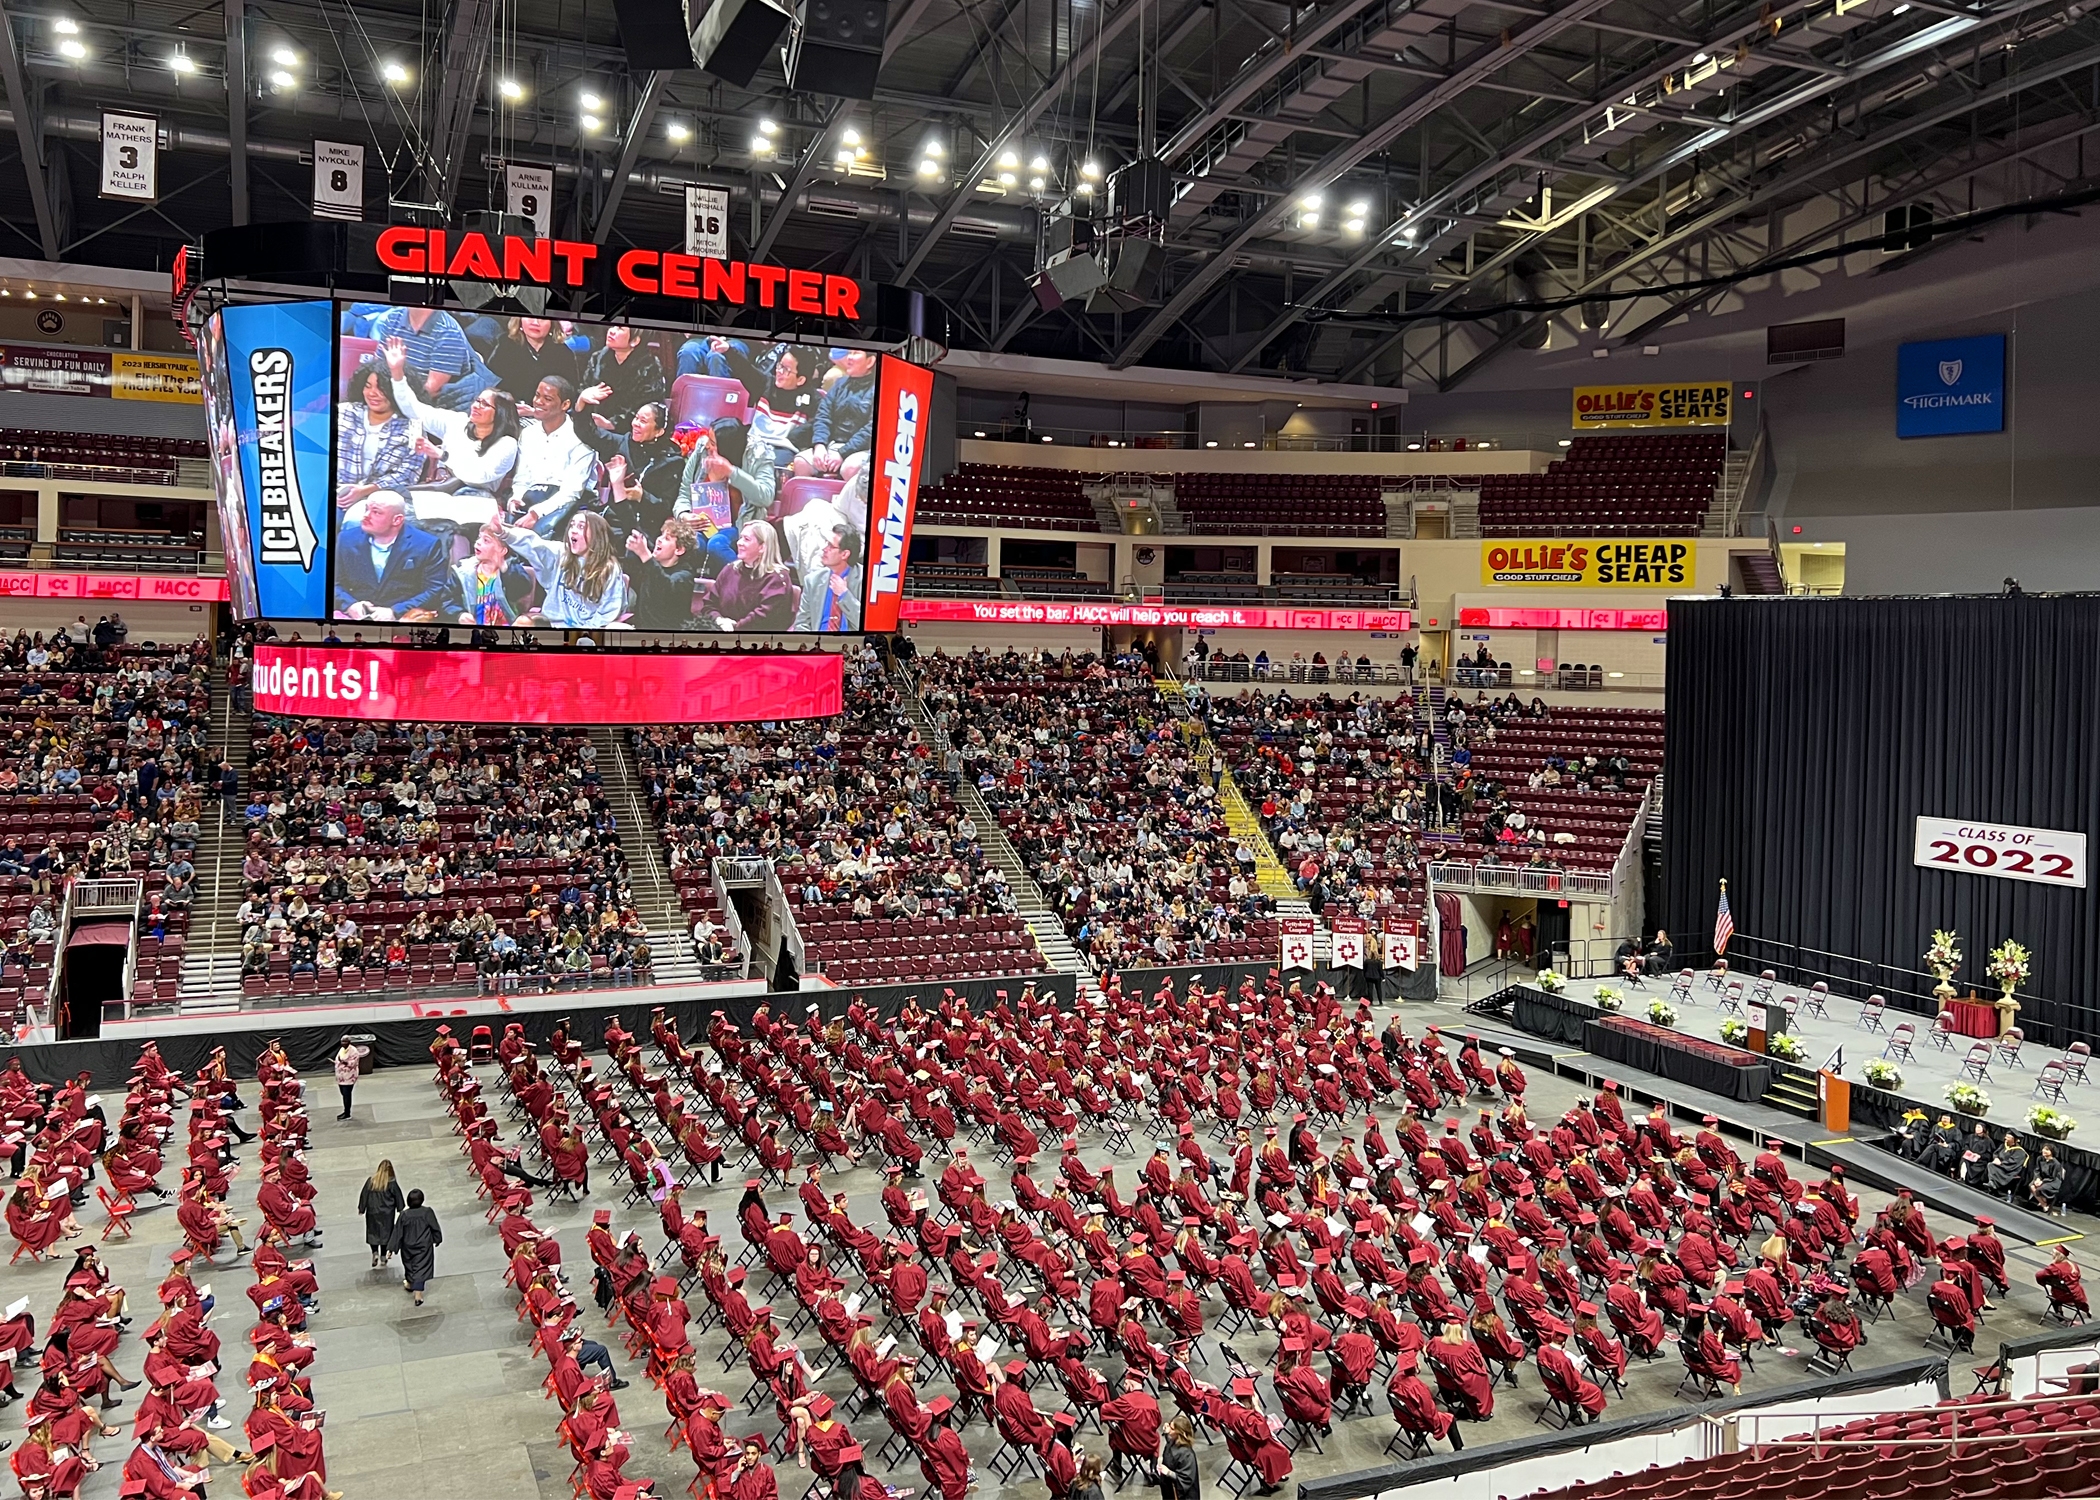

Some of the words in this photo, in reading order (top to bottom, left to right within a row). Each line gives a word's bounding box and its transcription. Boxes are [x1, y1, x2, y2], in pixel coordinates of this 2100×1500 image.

[112, 122, 146, 133] FRANK
[106, 131, 153, 143] MATHERS
[119, 145, 139, 169] 3
[328, 147, 350, 157] MIKE
[318, 155, 359, 167] NYKOLUK
[112, 170, 145, 181] RALPH
[330, 169, 348, 192] 8
[518, 173, 542, 183] ARNIE
[109, 179, 147, 190] KELLER
[511, 181, 549, 192] KULLMAN
[521, 194, 538, 217] 9
[689, 201, 725, 212] MARSHALL
[694, 214, 720, 235] 16
[696, 239, 717, 248] MITCH
[375, 226, 598, 286] GIANT
[617, 249, 861, 321] CENTER
[13, 356, 50, 368] SERVING
[51, 359, 63, 369] UP
[64, 360, 80, 371] FUN
[83, 361, 106, 372] DAILY
[122, 360, 142, 368] 2023
[143, 361, 189, 372] HERSHEYPARK
[162, 374, 185, 384] The
[152, 384, 174, 393] Fits
[1659, 387, 1730, 405] CHEAP
[1904, 392, 1992, 410] HIGHMARK
[1660, 402, 1728, 419] SEATS
[251, 350, 290, 506] BREAKERS
[262, 511, 302, 561] ICE
[1595, 543, 1687, 564] CHEAP
[1494, 573, 1524, 581] GOOD
[1524, 573, 1551, 581] STUFF
[1551, 573, 1579, 581] CHEAP
[1597, 564, 1685, 583] SEATS
[155, 580, 200, 597] HACC
[973, 603, 997, 619] You
[999, 605, 1020, 618] set
[1022, 604, 1044, 618] the
[1046, 605, 1070, 620] bar.
[1073, 607, 1108, 621] HACC
[1110, 608, 1130, 622] will
[1132, 608, 1161, 624] help
[1163, 611, 1188, 625] you
[1190, 609, 1229, 624] reach
[1232, 611, 1246, 624] it.
[1958, 827, 2007, 843] CLASS
[2012, 833, 2035, 846] OF
[1929, 840, 2075, 879] 2022
[1335, 919, 1361, 927] Harrisburg
[1388, 920, 1413, 928] Lancaster
